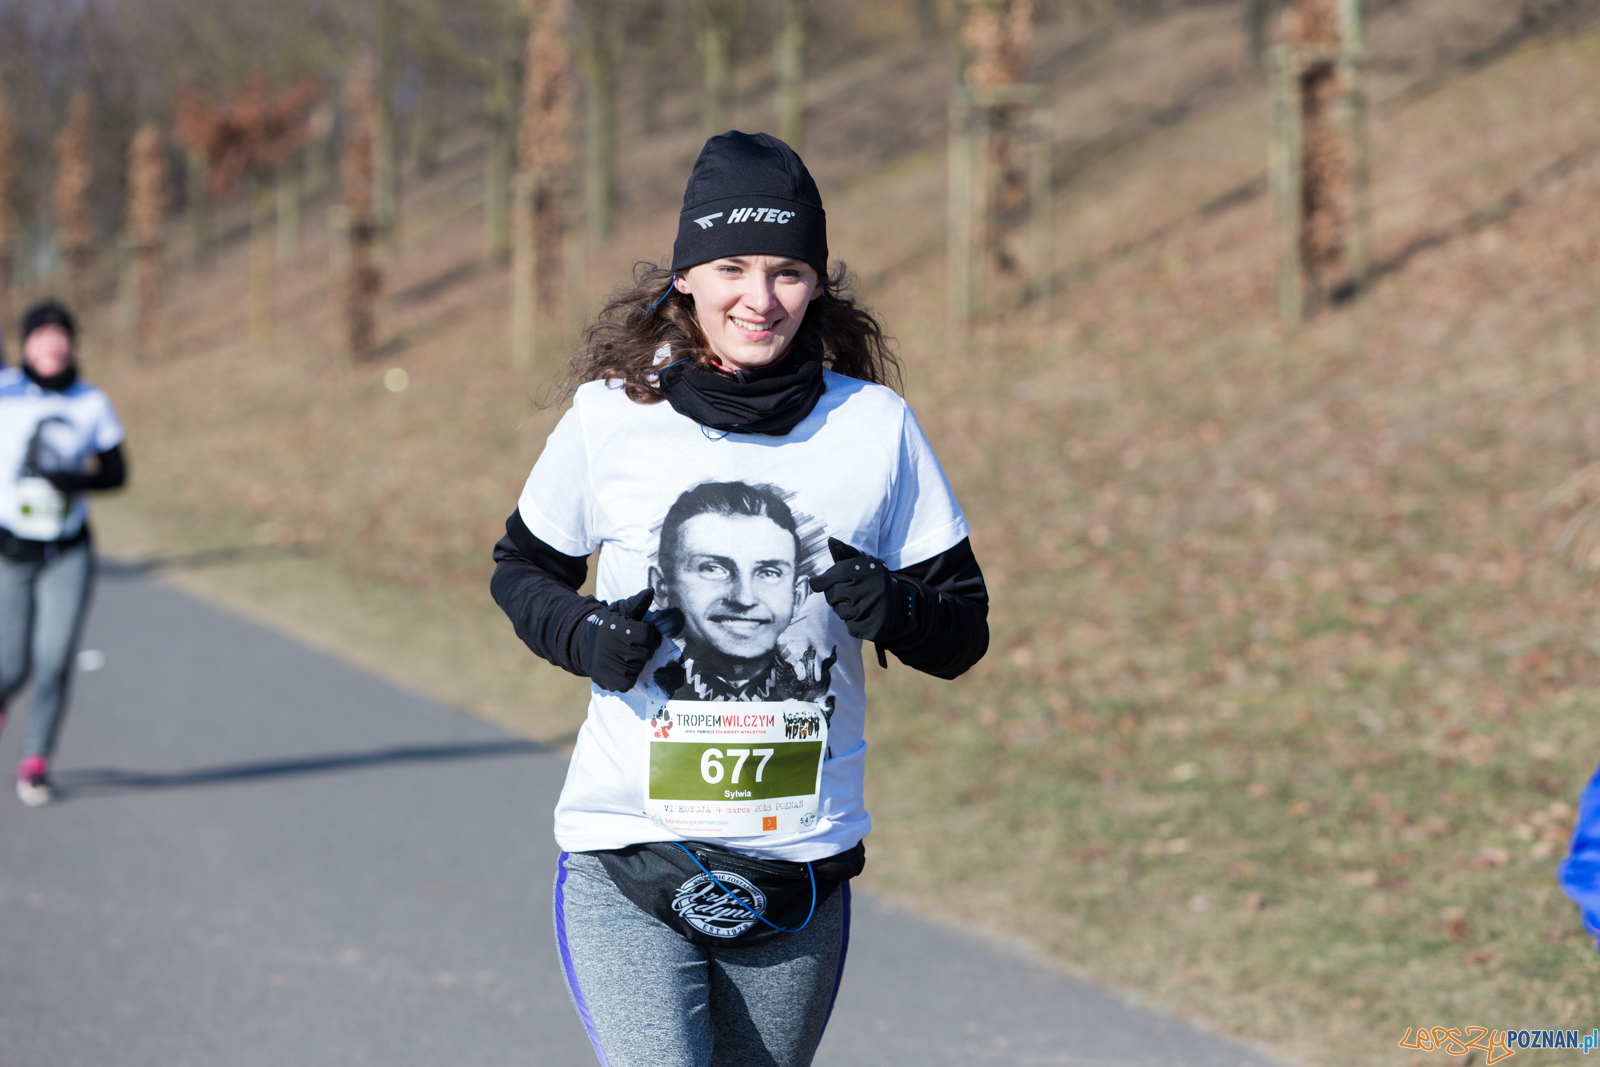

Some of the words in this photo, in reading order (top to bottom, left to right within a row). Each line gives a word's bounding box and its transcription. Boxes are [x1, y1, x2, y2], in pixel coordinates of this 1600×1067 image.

[727, 207, 795, 224] HI-TEC
[700, 747, 775, 785] 677
[724, 789, 752, 800] Sylwia
[664, 804, 674, 812] VI
